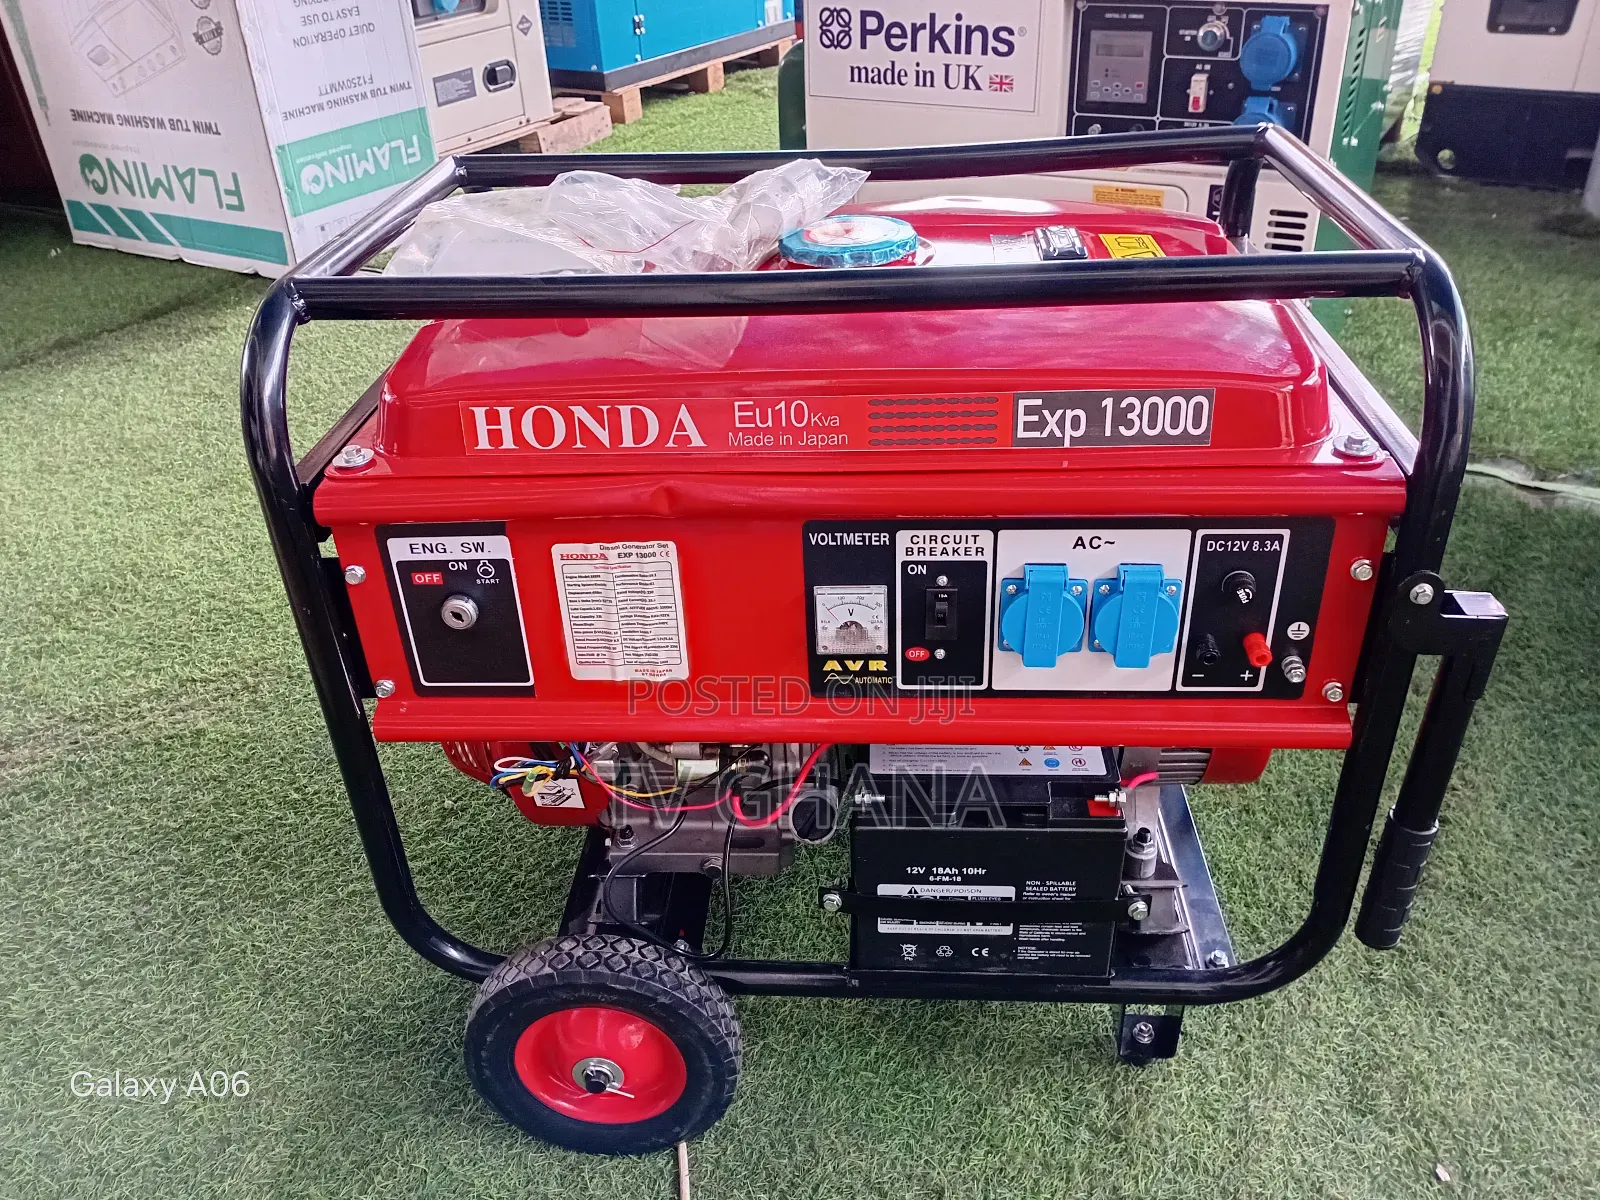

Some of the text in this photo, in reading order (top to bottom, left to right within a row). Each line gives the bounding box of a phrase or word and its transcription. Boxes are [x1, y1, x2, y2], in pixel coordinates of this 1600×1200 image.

[300, 6, 360, 26] EASY TO USE
[293, 22, 375, 48] QUIET OPERATION
[859, 10, 1015, 57] Perkins
[850, 60, 983, 91] made in UK
[282, 81, 412, 120] TWIN TUB WASHING MACHINE
[70, 108, 221, 136] TWIN TUB WASHING MACHINE
[469, 403, 707, 450] HONDA
[1016, 395, 1208, 447] Exp 13000
[728, 430, 849, 449] Made in Japan
[809, 532, 890, 546] VOLTMETER
[910, 534, 980, 545] CIRCUIT
[409, 541, 492, 554] ENG. SW.
[621, 543, 655, 551] Generator
[1206, 540, 1280, 552] DC12V 8.3A
[635, 551, 657, 559] 13000
[905, 547, 985, 557] BREAKER
[448, 561, 468, 571] ON
[907, 564, 927, 575] ON
[414, 573, 440, 583] OFF
[847, 608, 854, 617] V
[908, 650, 925, 658] OFF
[822, 660, 888, 671] AVR
[854, 676, 893, 685] AUTOMATIC
[932, 867, 959, 875] 18Ah
[961, 867, 988, 875] 10Hr
